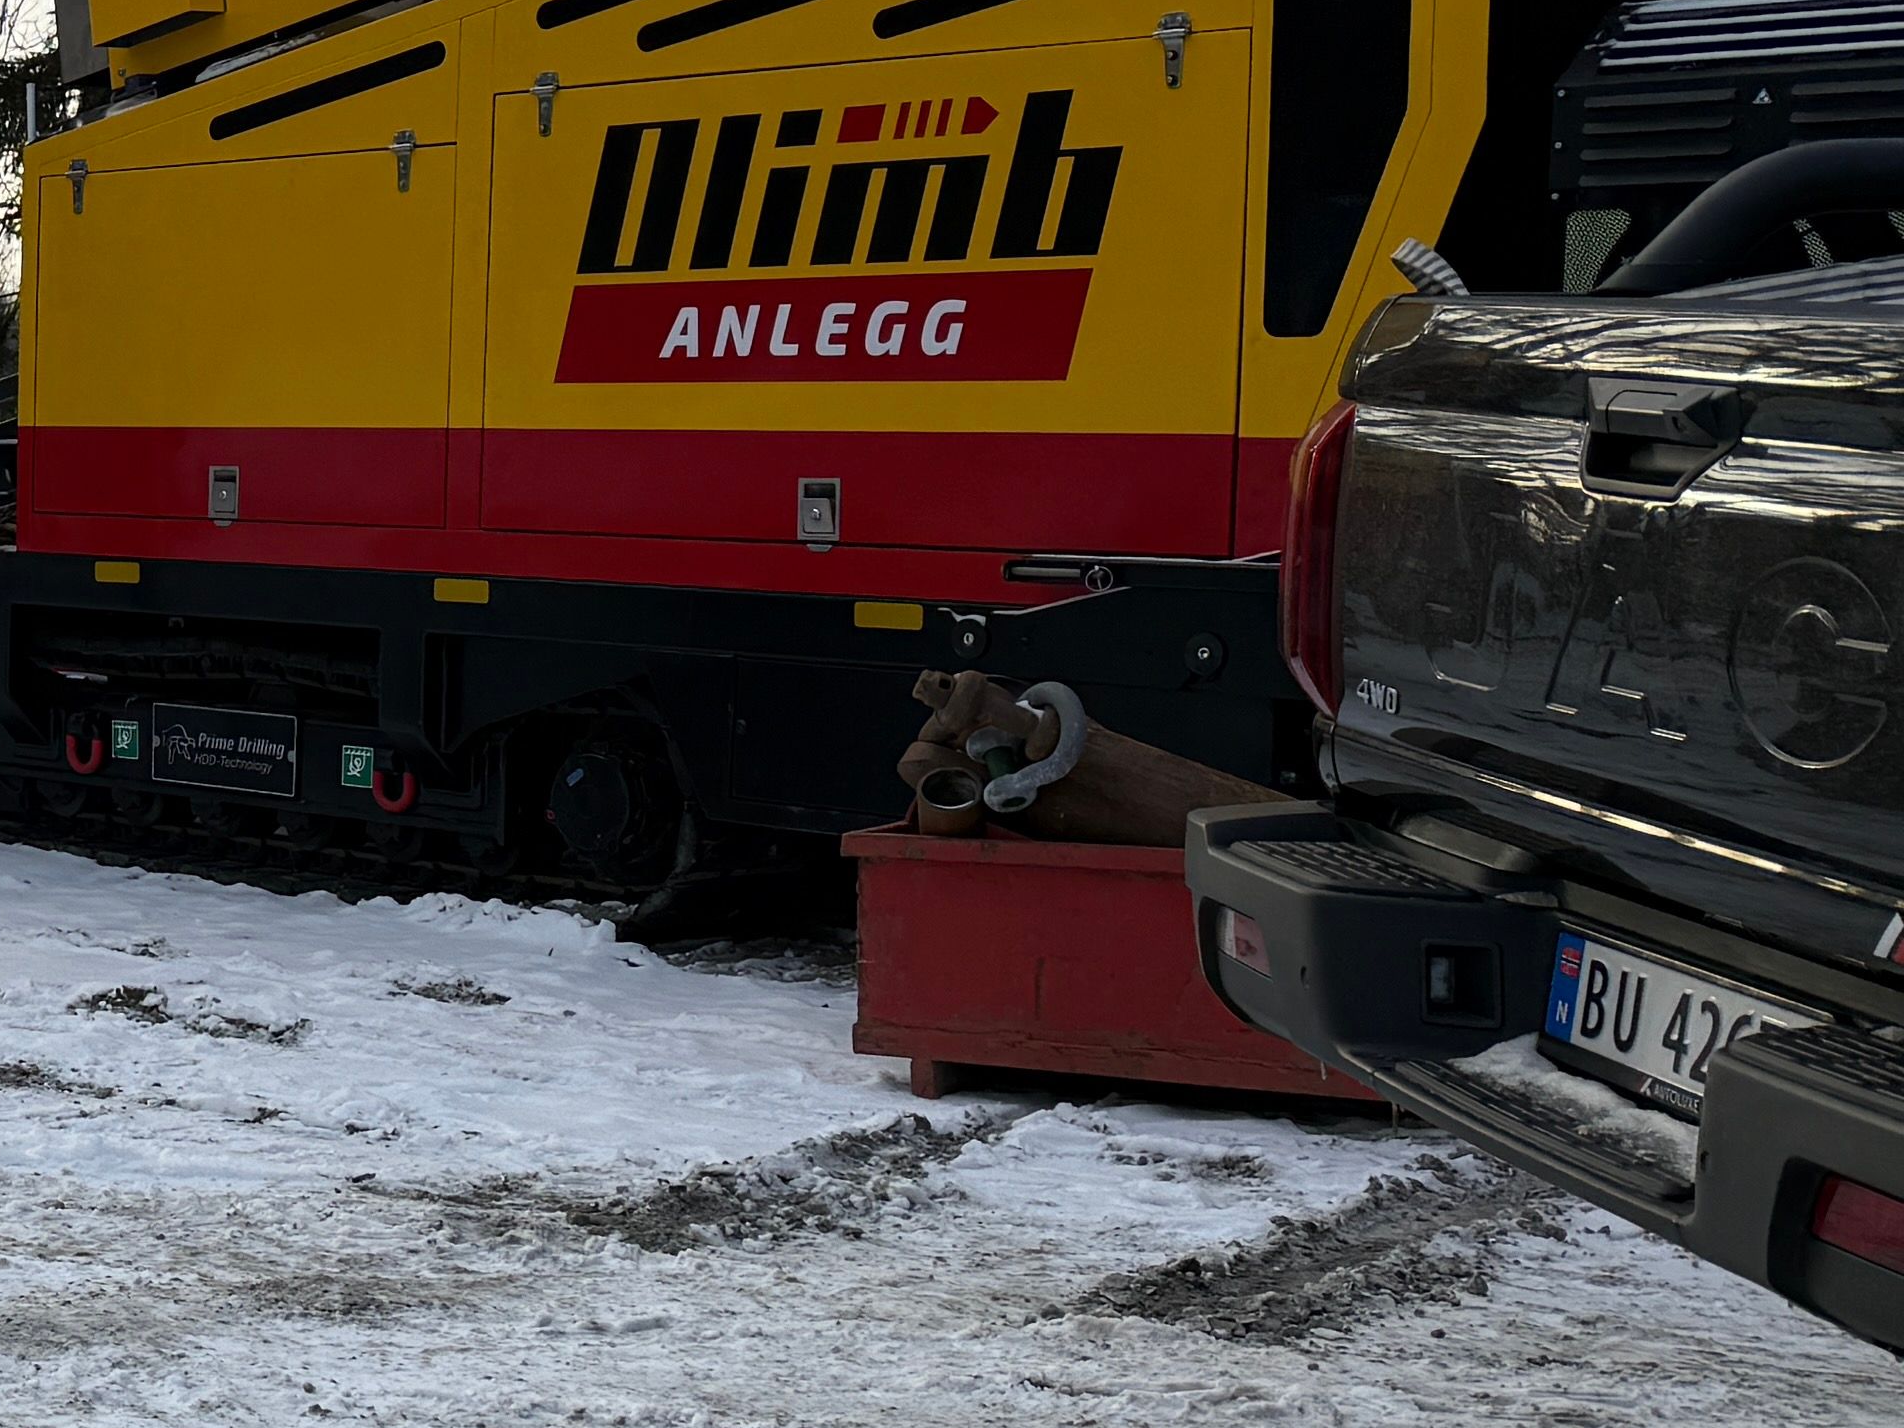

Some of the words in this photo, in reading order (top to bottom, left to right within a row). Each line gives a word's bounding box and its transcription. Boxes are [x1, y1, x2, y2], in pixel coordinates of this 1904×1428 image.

[659, 299, 967, 358] ANLEGG
[1356, 678, 1398, 714] 4WD
[198, 732, 234, 751] Prime
[238, 736, 285, 760] Drilling
[1555, 1000, 1569, 1024] N
[1580, 958, 1648, 1053] BU
